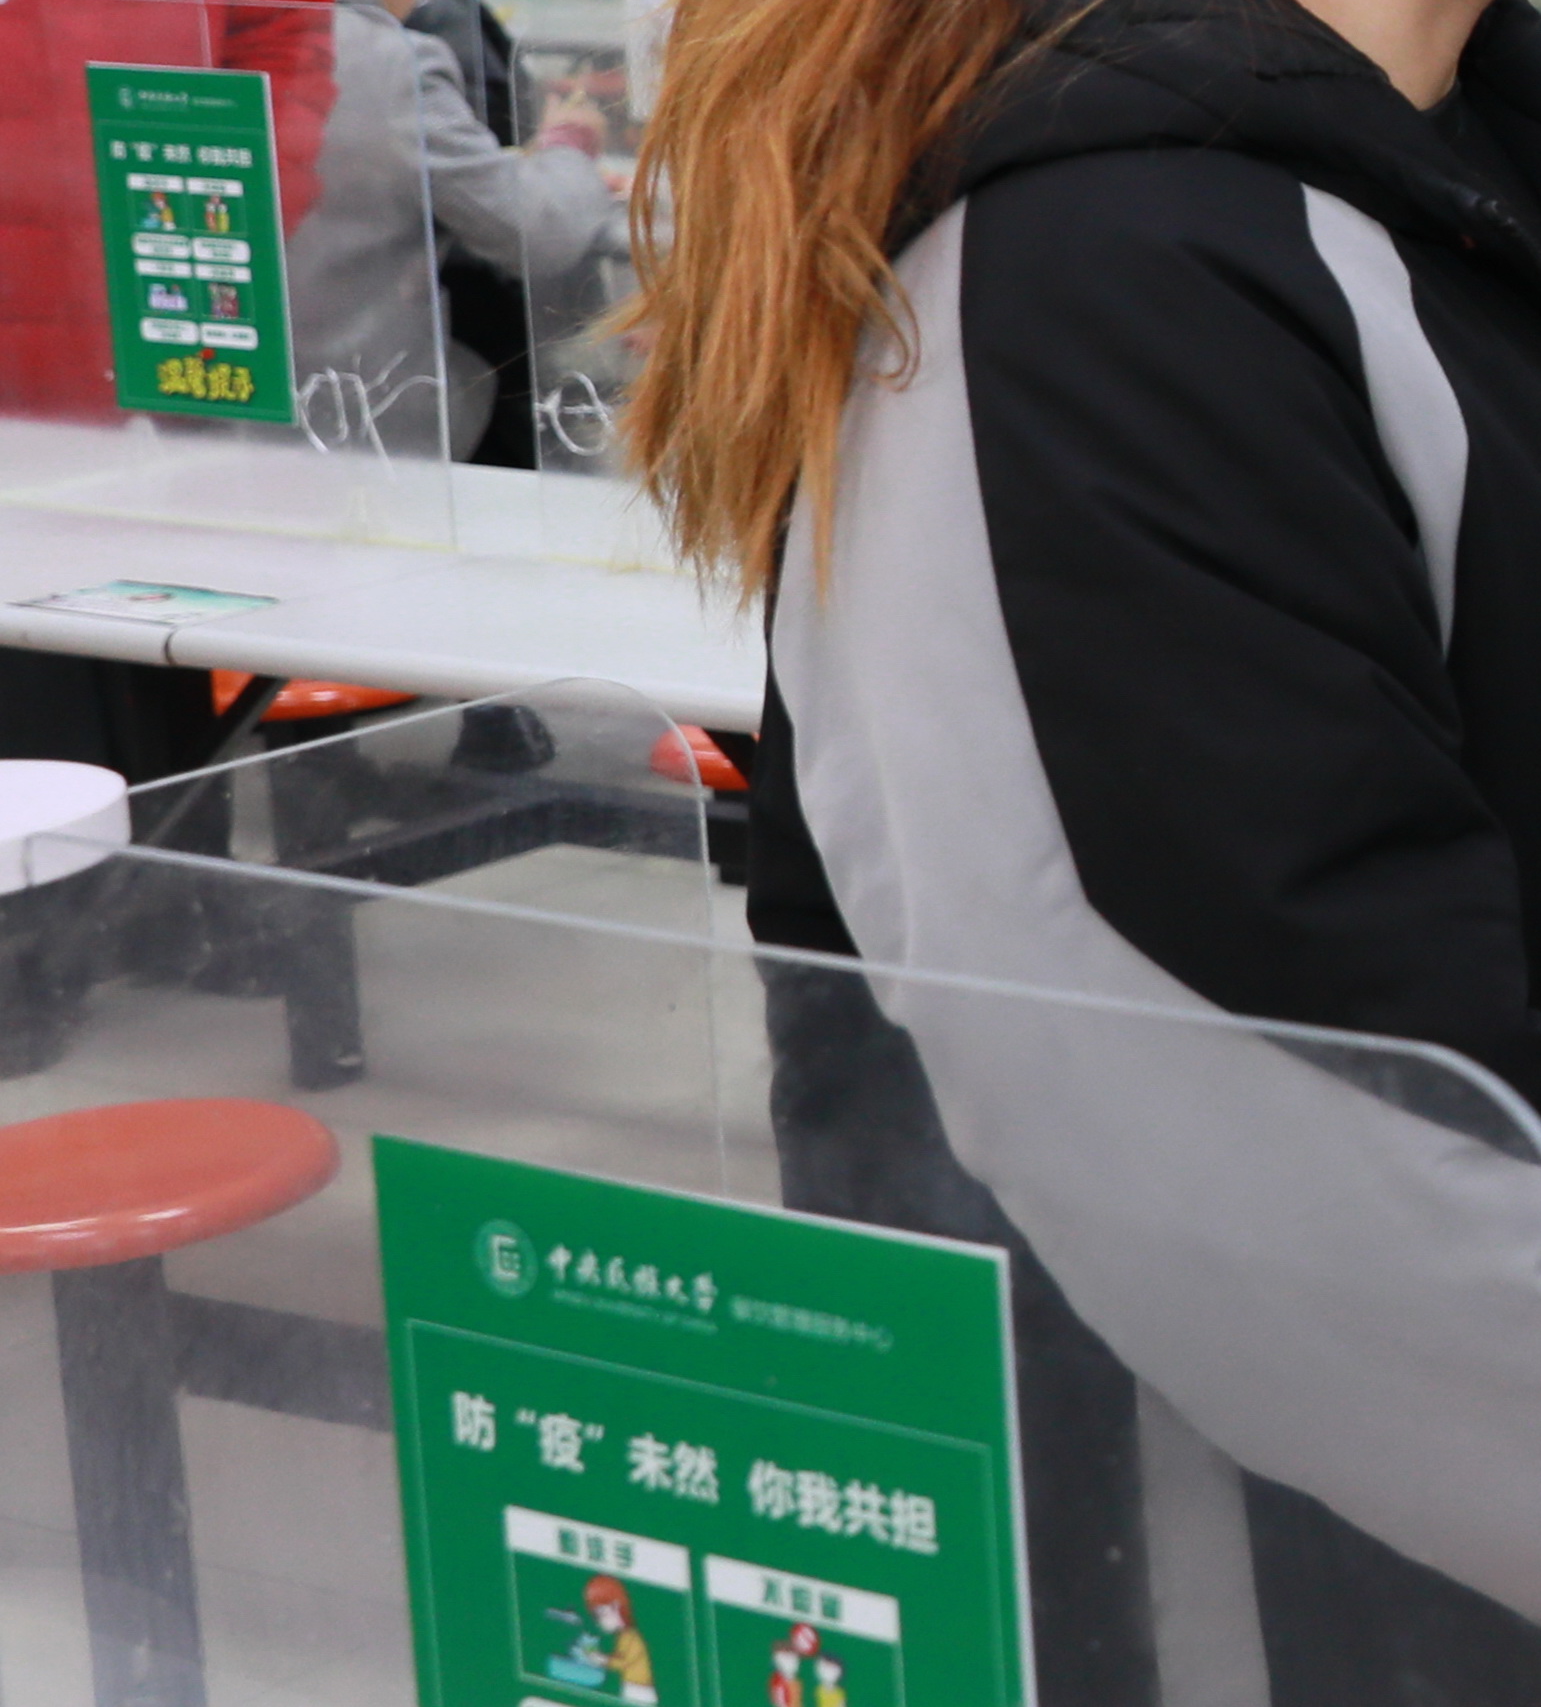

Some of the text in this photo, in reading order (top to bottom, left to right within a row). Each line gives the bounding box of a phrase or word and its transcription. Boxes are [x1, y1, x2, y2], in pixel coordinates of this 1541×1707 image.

[546, 1243, 718, 1315] 中央民族大学
[451, 1390, 939, 1554] 防 “疫” 未然 你我共担
